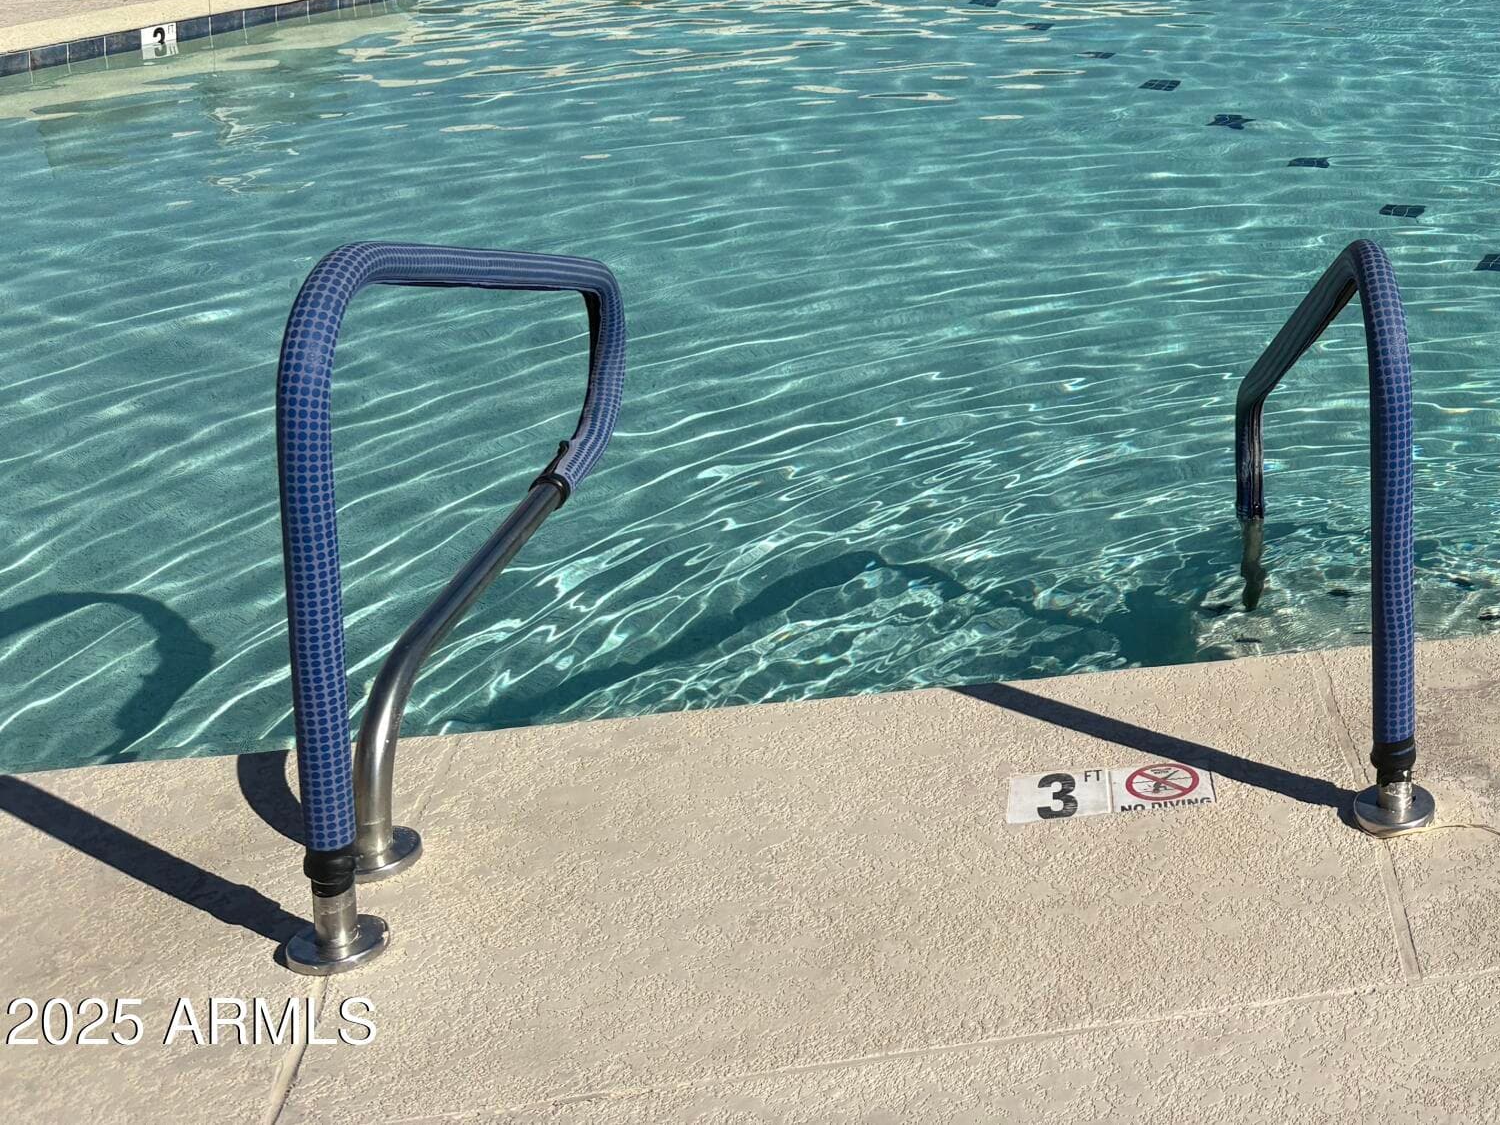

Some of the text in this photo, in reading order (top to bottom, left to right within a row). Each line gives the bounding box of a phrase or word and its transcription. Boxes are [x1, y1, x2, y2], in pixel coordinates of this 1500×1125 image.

[1037, 769, 1103, 819] 3 FT
[1120, 796, 1212, 812] NO DIVING
